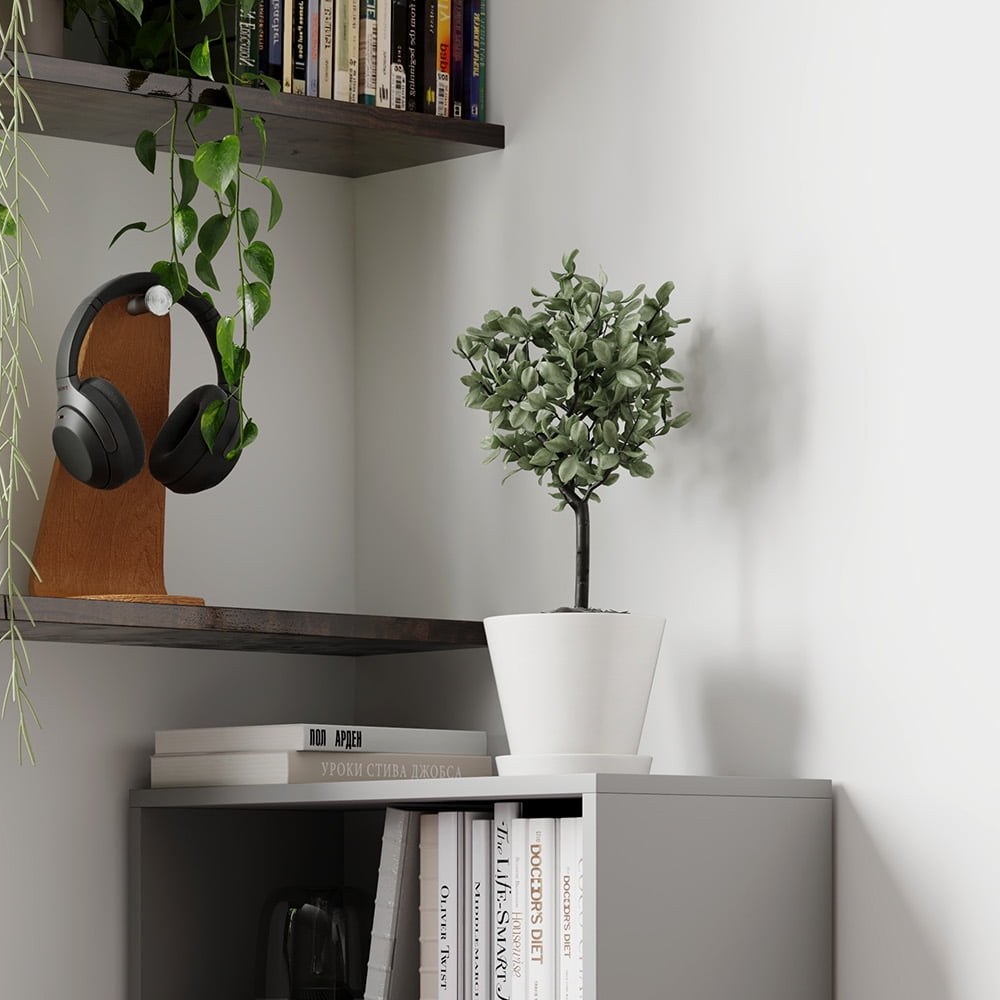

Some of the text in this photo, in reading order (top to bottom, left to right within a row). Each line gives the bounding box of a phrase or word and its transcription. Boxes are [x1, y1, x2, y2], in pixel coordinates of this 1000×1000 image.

[309, 728, 362, 750] ПОЛ АРДЕН
[321, 761, 462, 779] УРОКИ СТИВА ДЖОБСА
[440, 885, 450, 990] OLIVER TWIST
[530, 928, 543, 964] DIET
[563, 934, 571, 958] DIET
